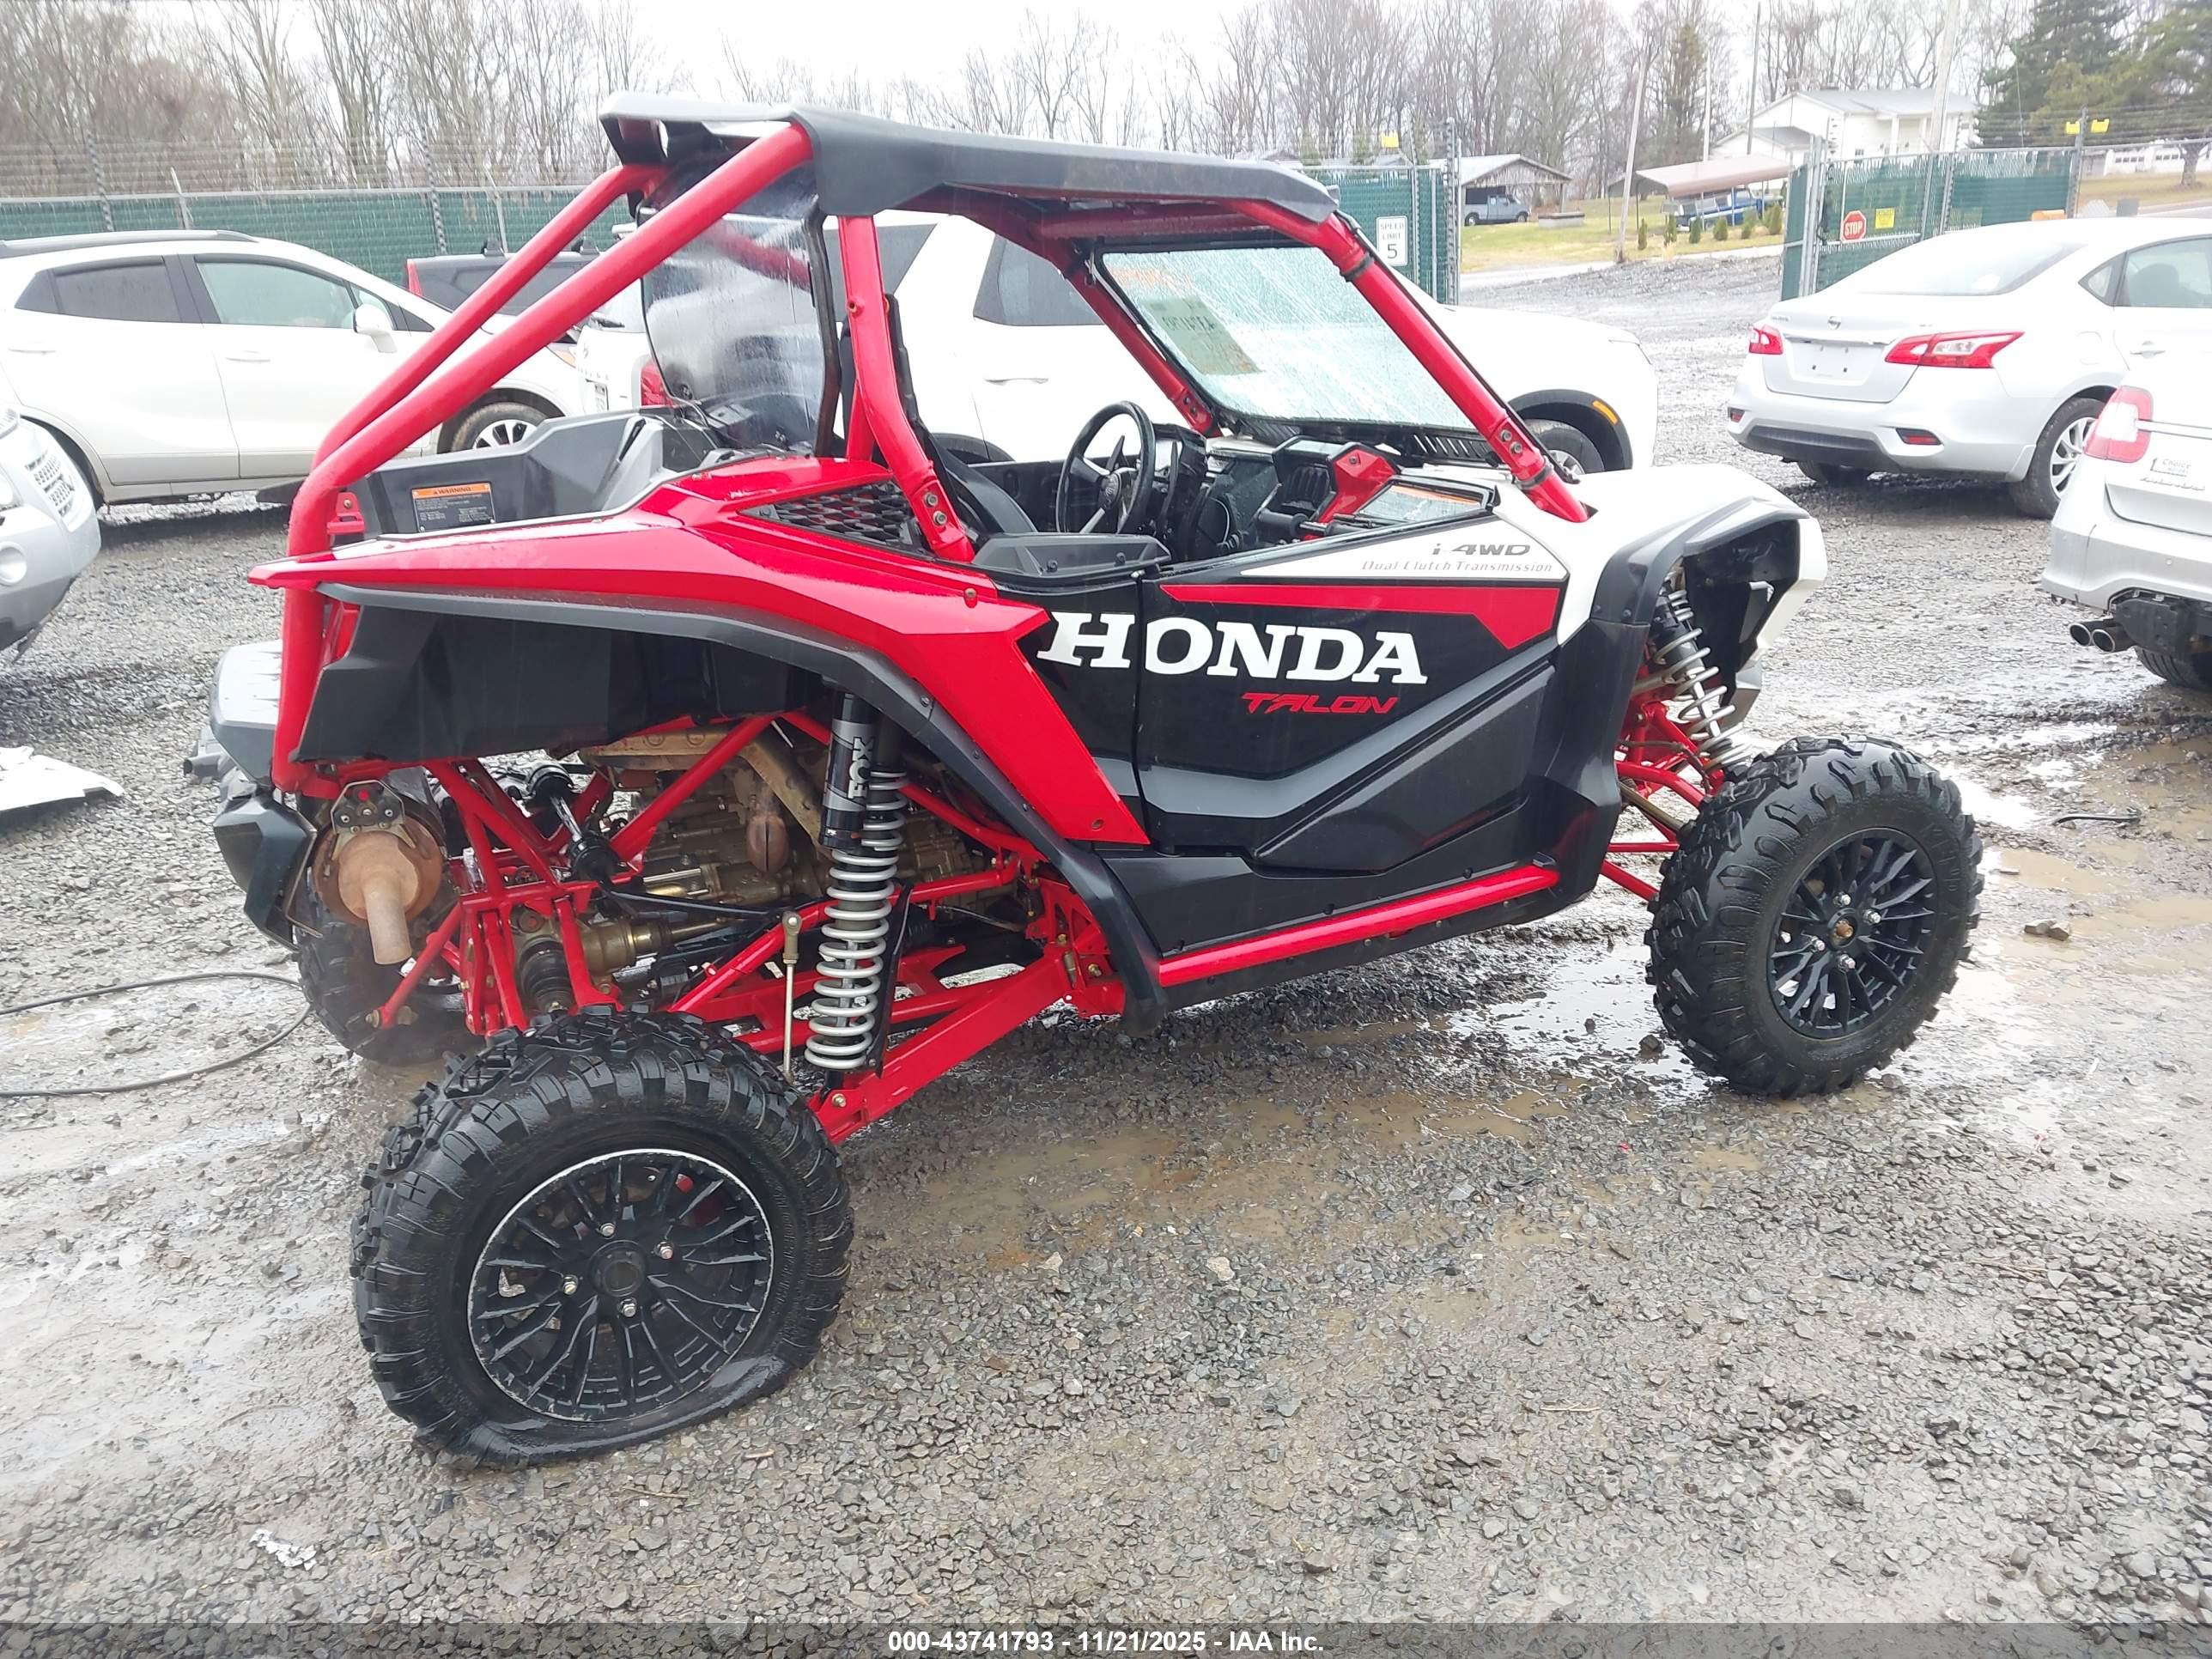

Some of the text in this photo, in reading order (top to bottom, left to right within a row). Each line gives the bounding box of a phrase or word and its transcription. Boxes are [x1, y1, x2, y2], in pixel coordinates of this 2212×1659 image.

[1844, 220, 1863, 235] STOP
[1387, 243, 1398, 259] 5
[1451, 544, 1531, 556] 4WD
[1362, 560, 1553, 572] Dual Clutch Transmission
[1036, 611, 1429, 684] HONDA
[1241, 692, 1399, 714] TALON
[848, 736, 873, 799] FOX
